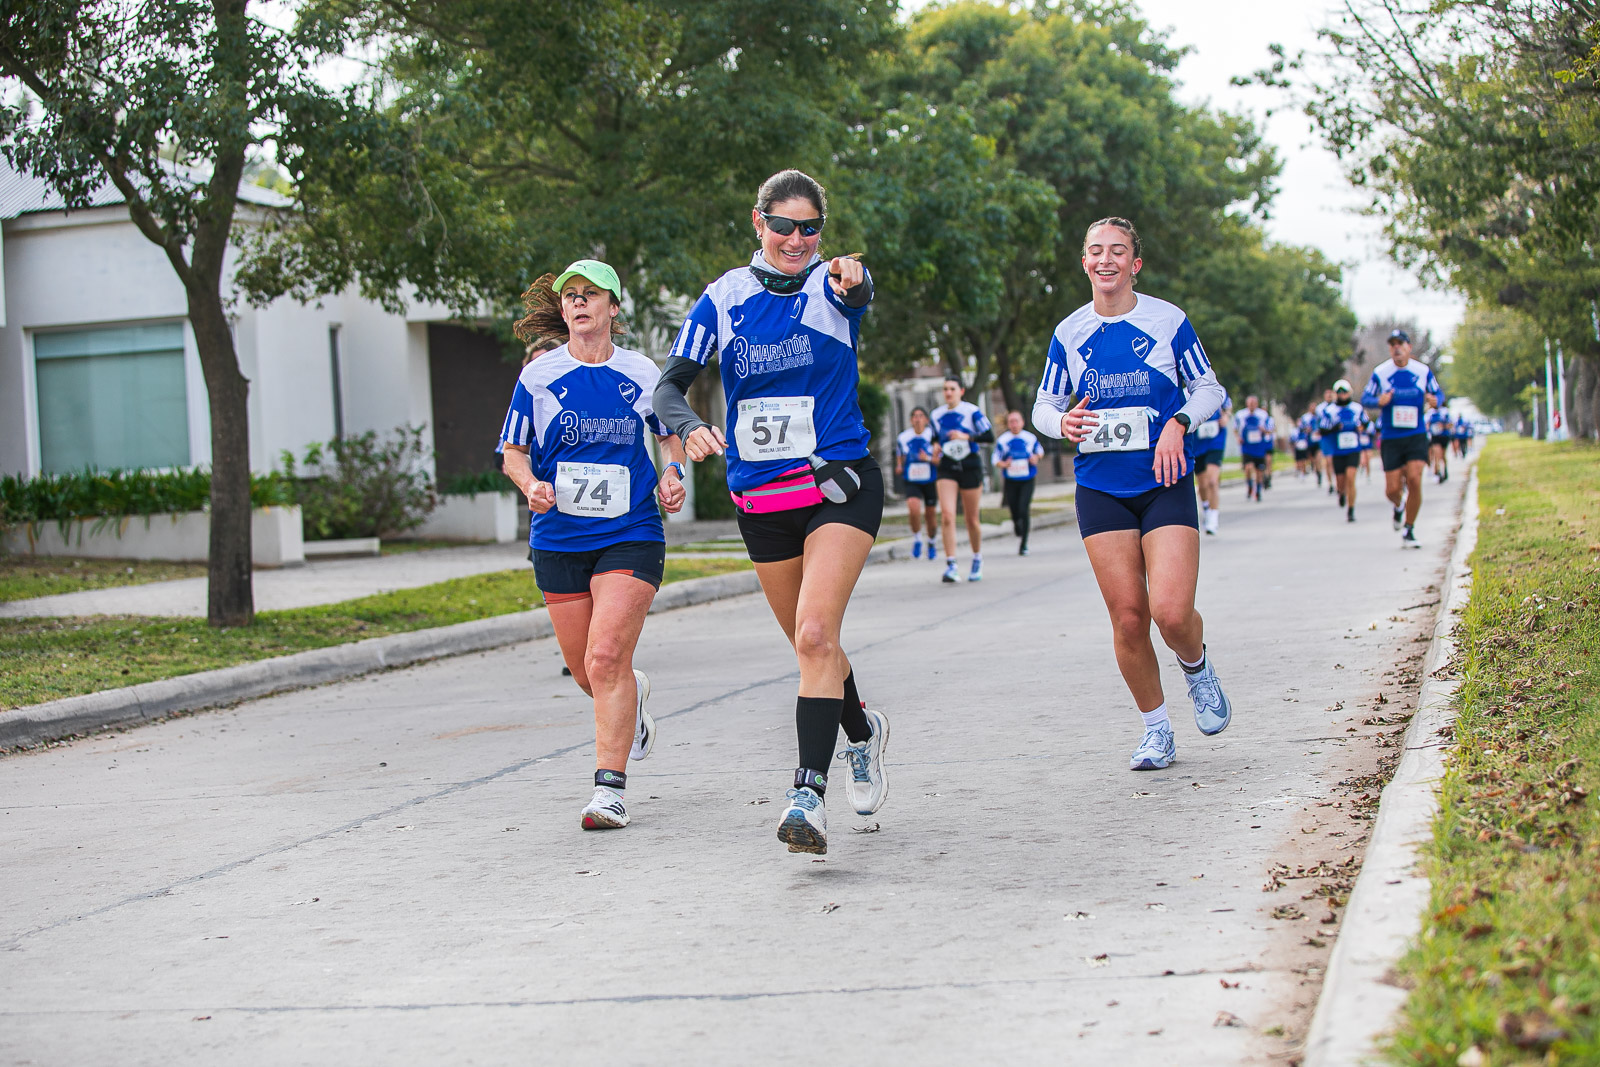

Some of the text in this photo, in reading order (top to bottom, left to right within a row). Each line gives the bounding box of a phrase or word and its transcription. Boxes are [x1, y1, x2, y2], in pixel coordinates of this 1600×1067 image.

[733, 333, 812, 379] 3 MARATÓN
[1084, 368, 1150, 403] 3 MARATÓN
[559, 409, 637, 446] 3 MARATÓN
[751, 415, 791, 446] 57
[1093, 422, 1132, 448] 49
[572, 478, 612, 506] 74
